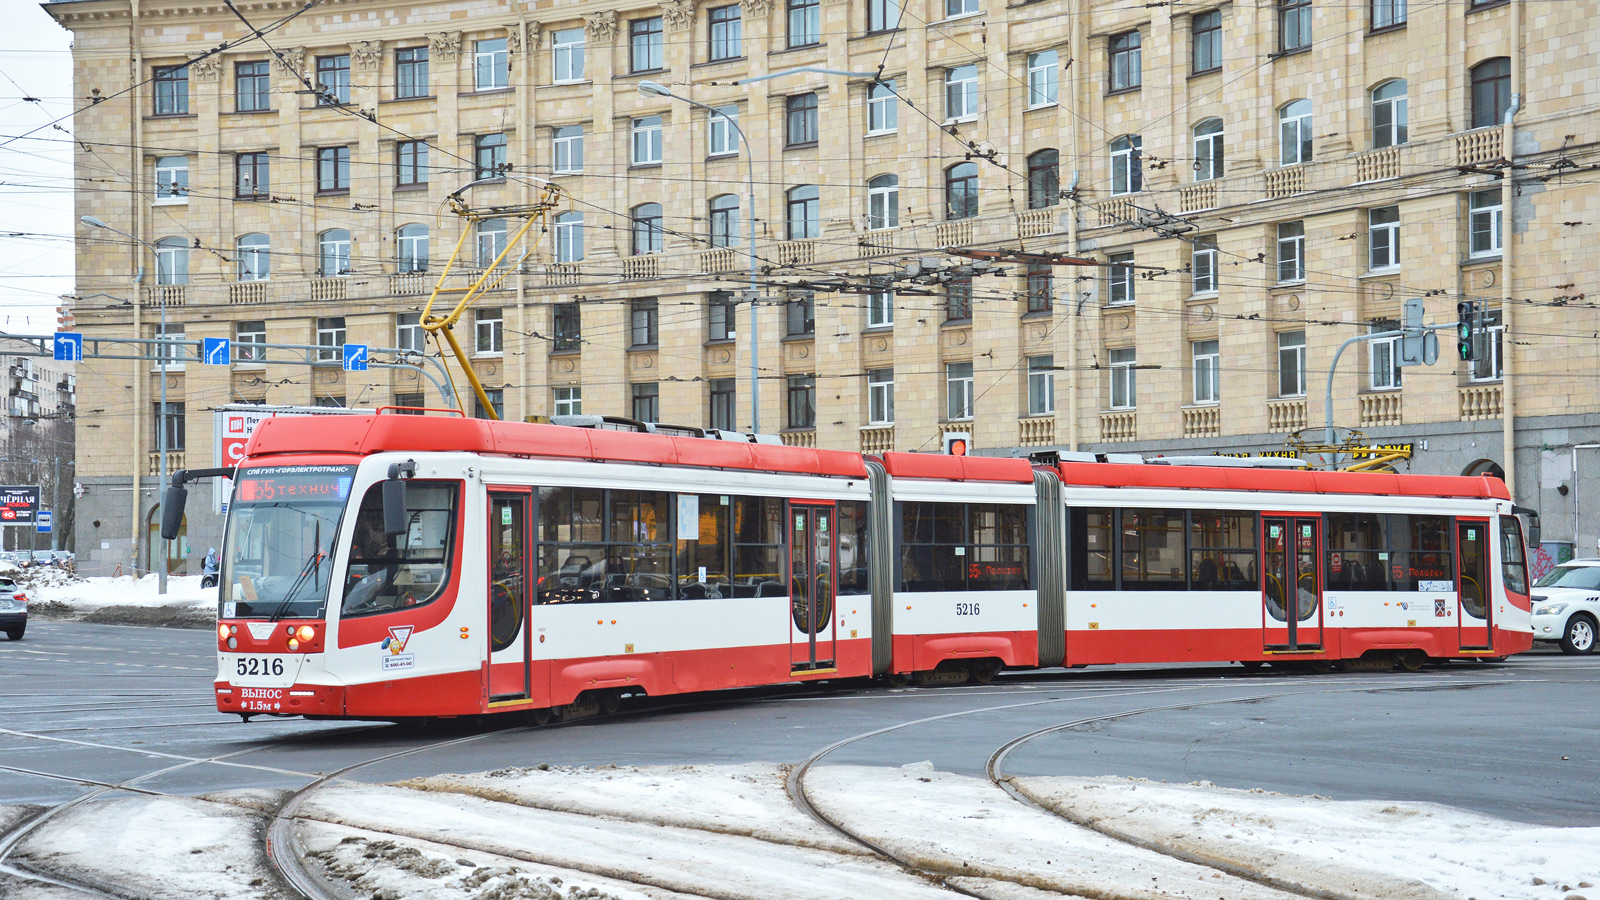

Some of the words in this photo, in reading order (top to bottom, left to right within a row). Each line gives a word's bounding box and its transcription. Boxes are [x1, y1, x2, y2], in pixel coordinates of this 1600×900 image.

[275, 466, 348, 474] «ГОРЭЛЕКТРОТРАНС»
[956, 603, 980, 615] 5216
[237, 657, 284, 676] 5216
[241, 688, 282, 699] ВЫНОС
[249, 701, 272, 711] 1.5м
